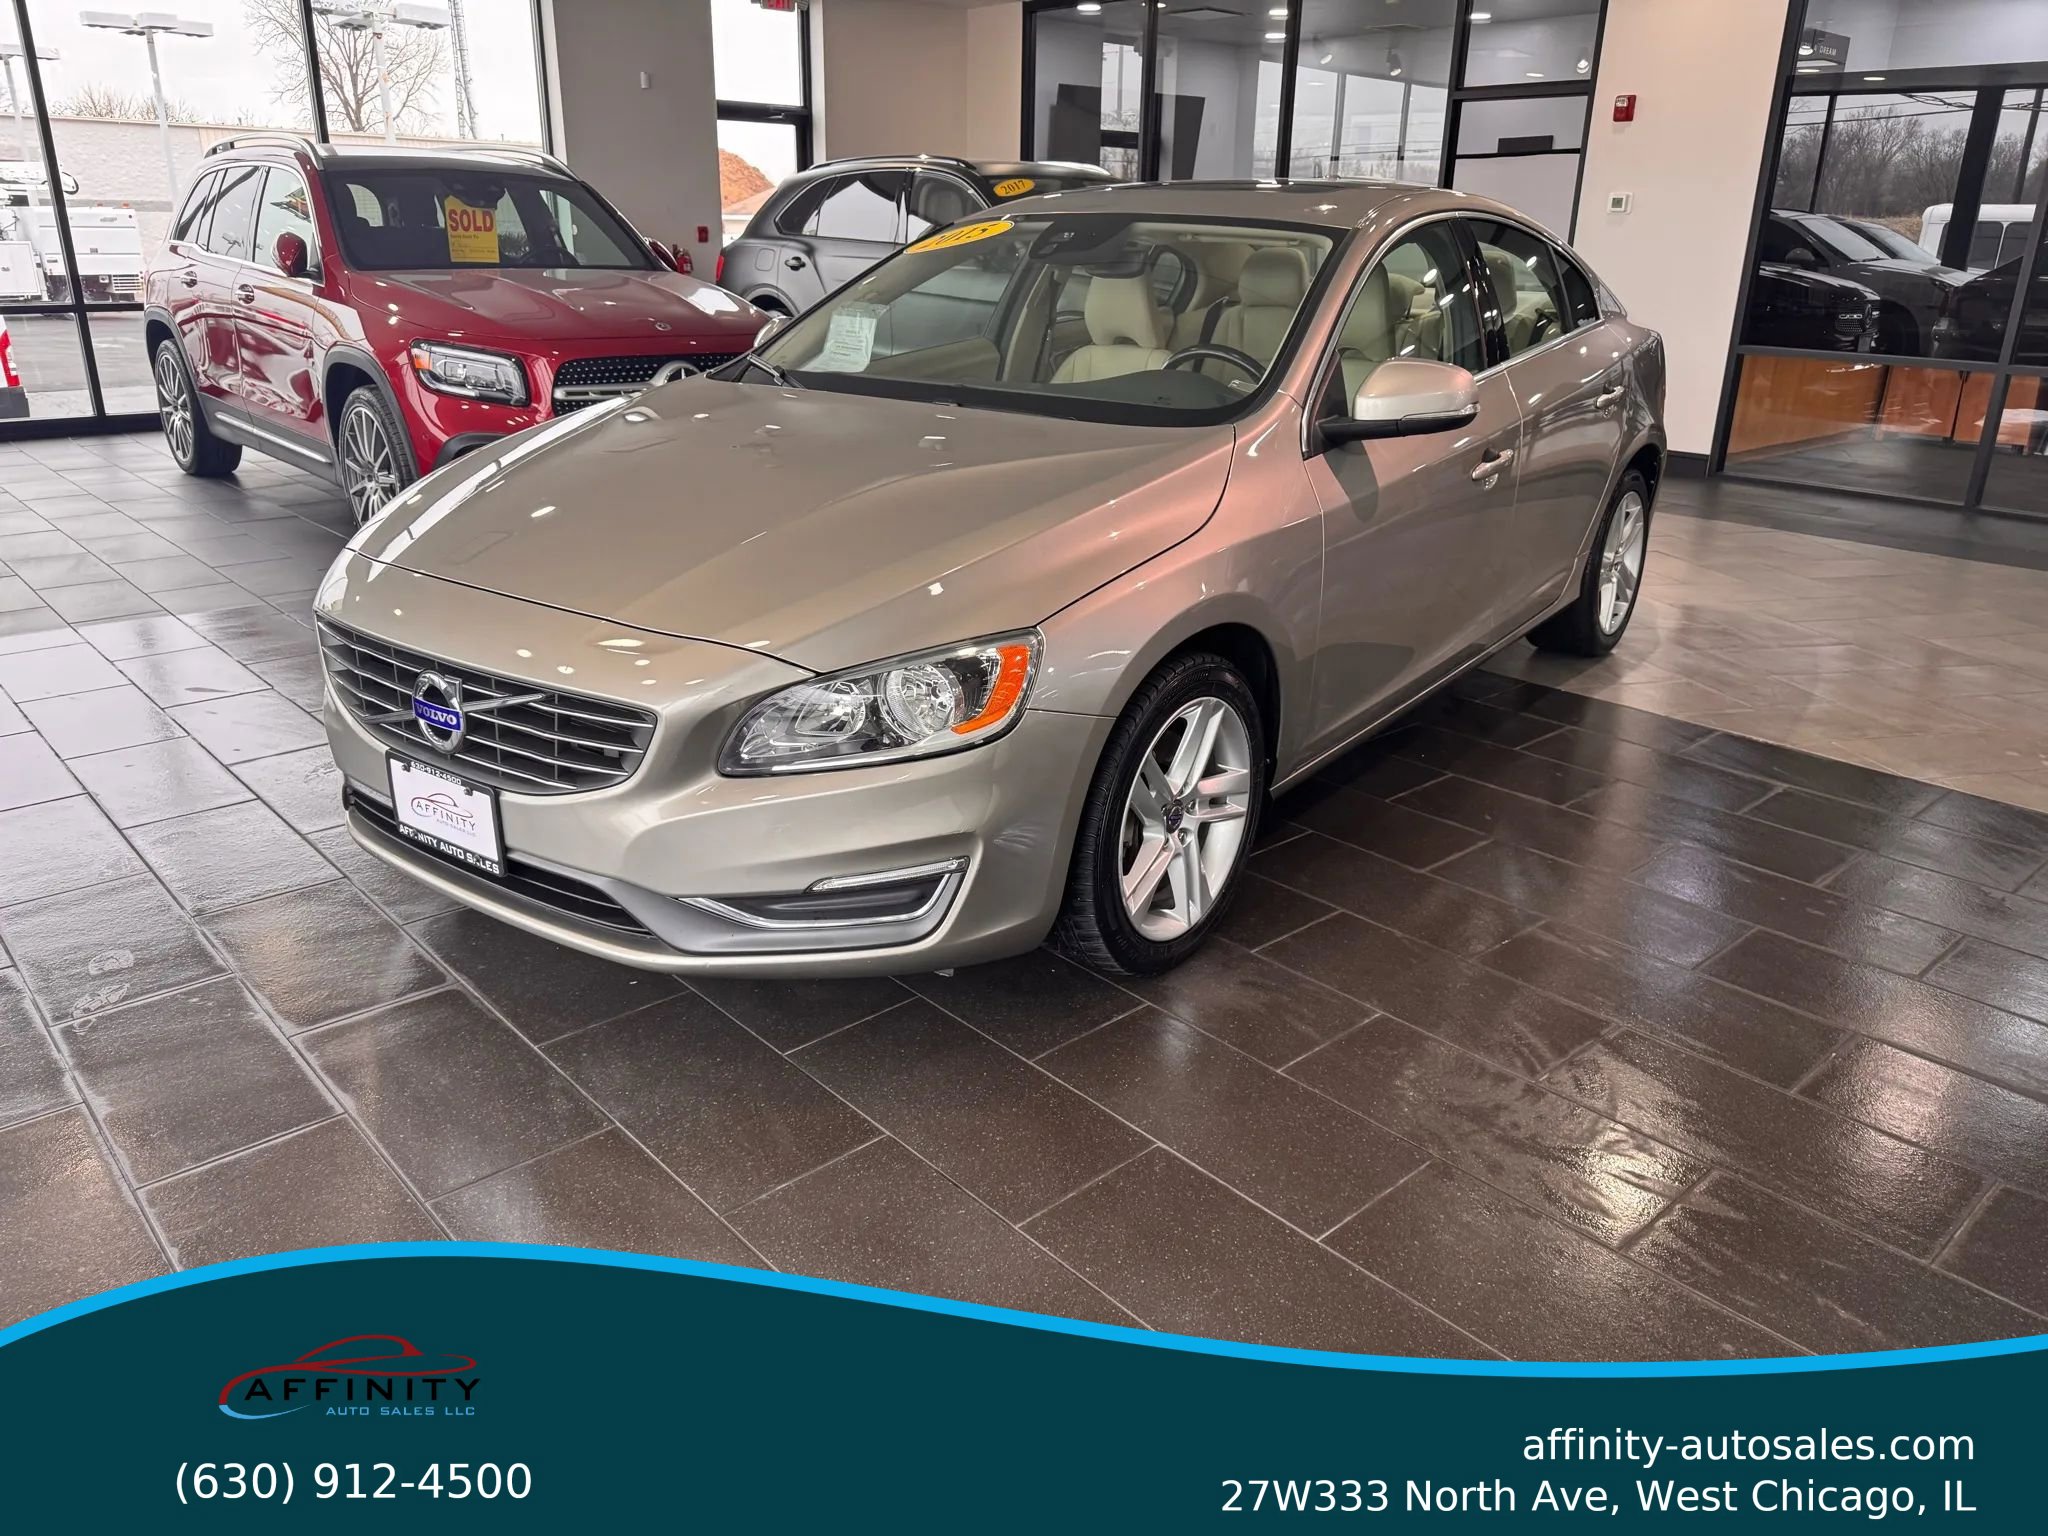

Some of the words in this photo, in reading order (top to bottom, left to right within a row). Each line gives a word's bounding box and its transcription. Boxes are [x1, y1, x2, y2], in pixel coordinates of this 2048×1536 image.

[1001, 180, 1026, 194] 2017
[448, 208, 494, 232] SOLD
[414, 701, 457, 725] VOLVO
[410, 761, 462, 785] 630-912-4500
[416, 800, 476, 831] AFFINITY
[399, 823, 438, 848] AFFNITY
[440, 841, 465, 860] AUTO
